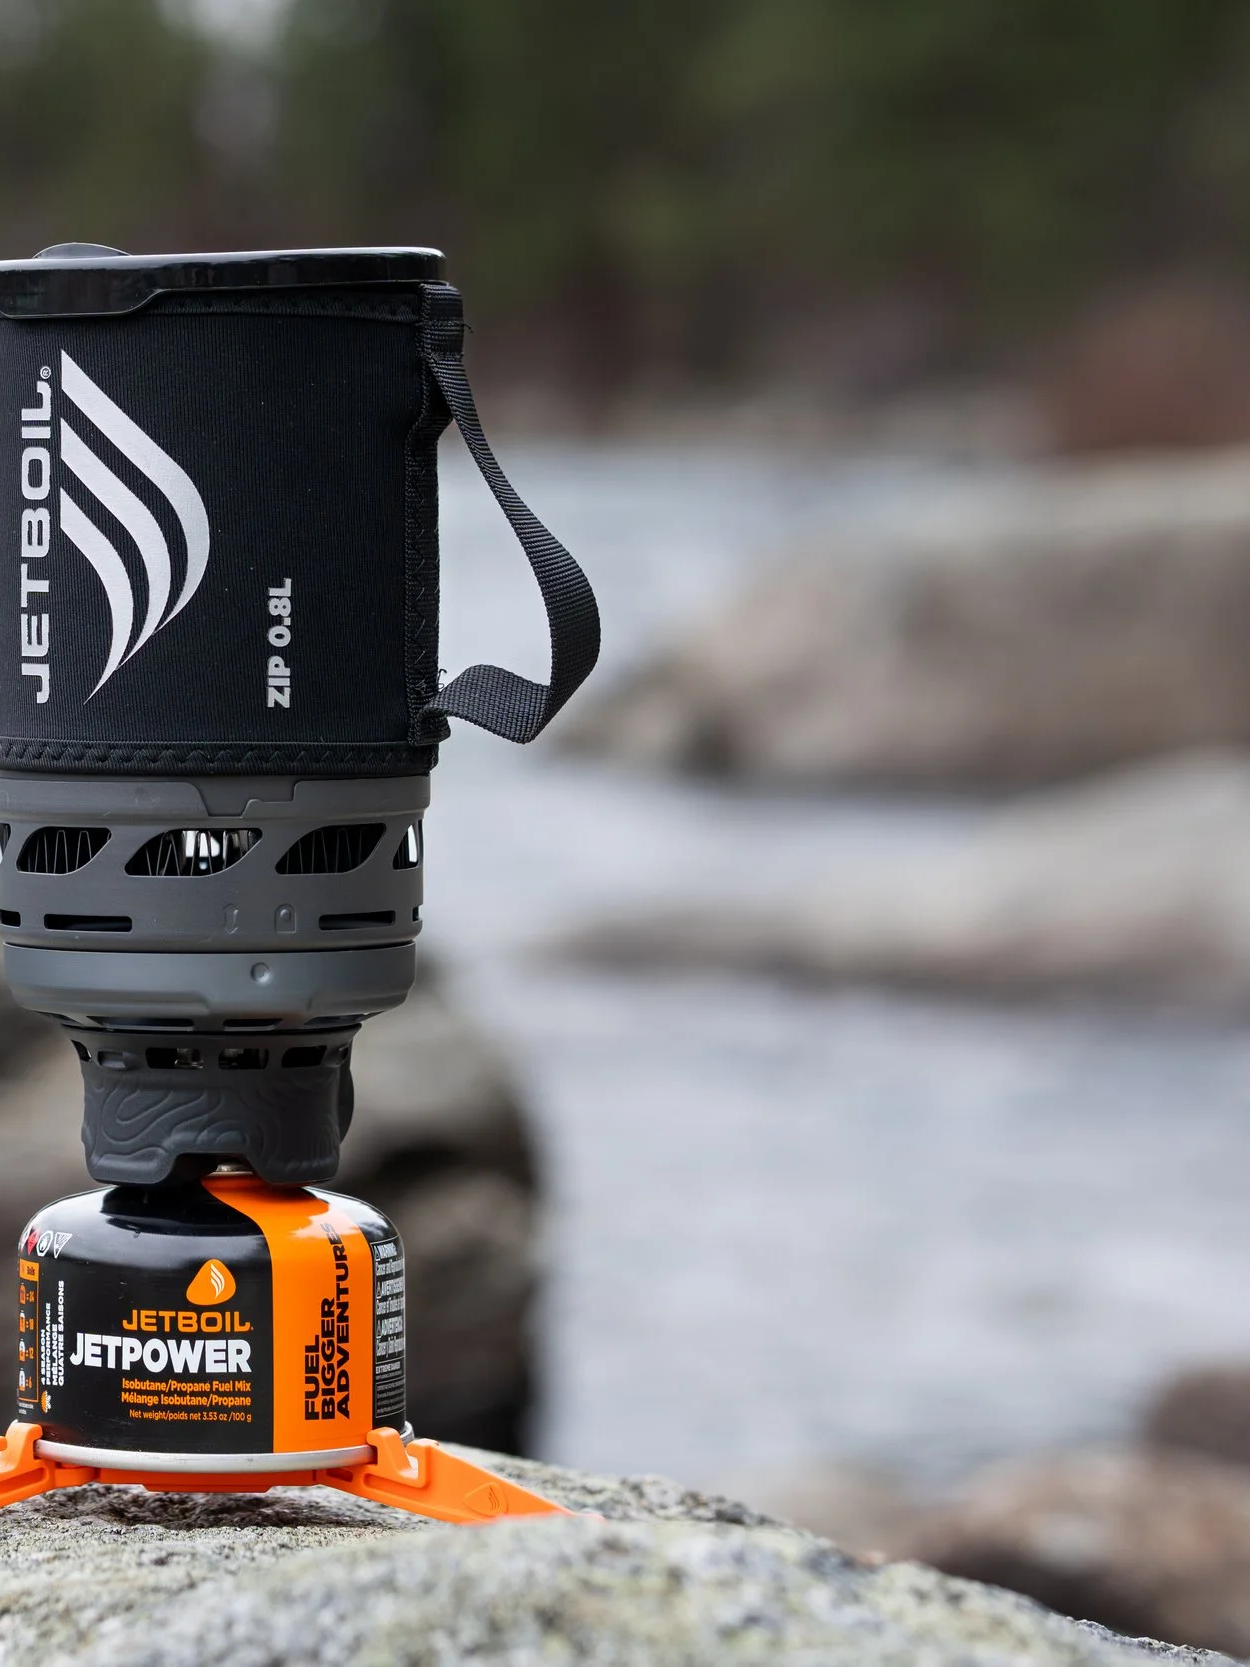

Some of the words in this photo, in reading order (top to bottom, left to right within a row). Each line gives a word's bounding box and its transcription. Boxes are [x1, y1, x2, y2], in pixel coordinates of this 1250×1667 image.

[267, 577, 292, 648] 0.8L
[267, 655, 292, 709] ZIP
[122, 1310, 251, 1333] JETBOIL
[320, 1222, 350, 1420] ADVENTURES
[69, 1332, 253, 1374] JETPOWER
[321, 1297, 336, 1420] BIGGER
[121, 1392, 160, 1407] Mélange
[161, 1394, 252, 1408] Isobutane/Propane
[122, 1378, 211, 1393] Isobutane/Propane
[212, 1380, 233, 1392] Fuel
[235, 1380, 252, 1392] Mix
[304, 1334, 320, 1421] FUEL
[130, 1409, 142, 1419] Net
[143, 1410, 188, 1422] weight/poids
[190, 1411, 201, 1421] net
[202, 1411, 218, 1421] 3.53
[219, 1413, 228, 1421] oz
[246, 1413, 252, 1423] g
